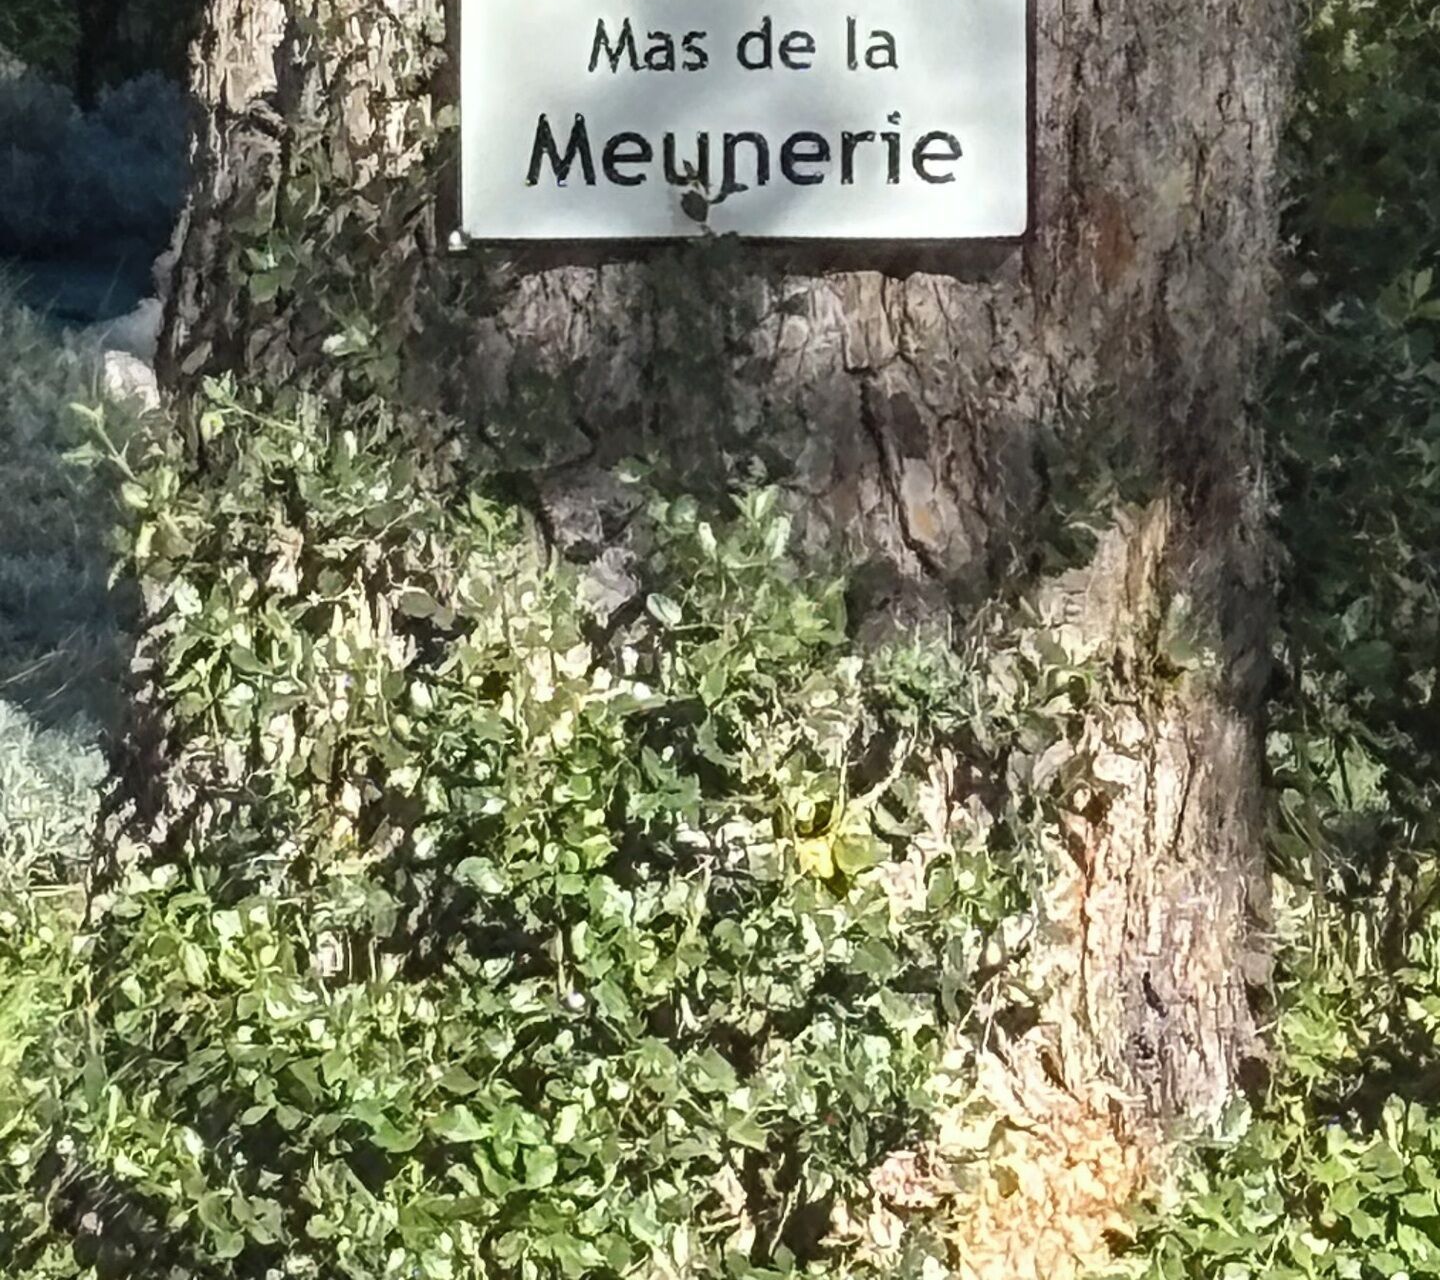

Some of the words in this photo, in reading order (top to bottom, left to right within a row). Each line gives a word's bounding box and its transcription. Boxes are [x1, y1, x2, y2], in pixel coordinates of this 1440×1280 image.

[588, 17, 709, 73] Mas
[736, 15, 816, 71] de
[846, 16, 899, 71] la
[525, 111, 963, 188] Meunerie
